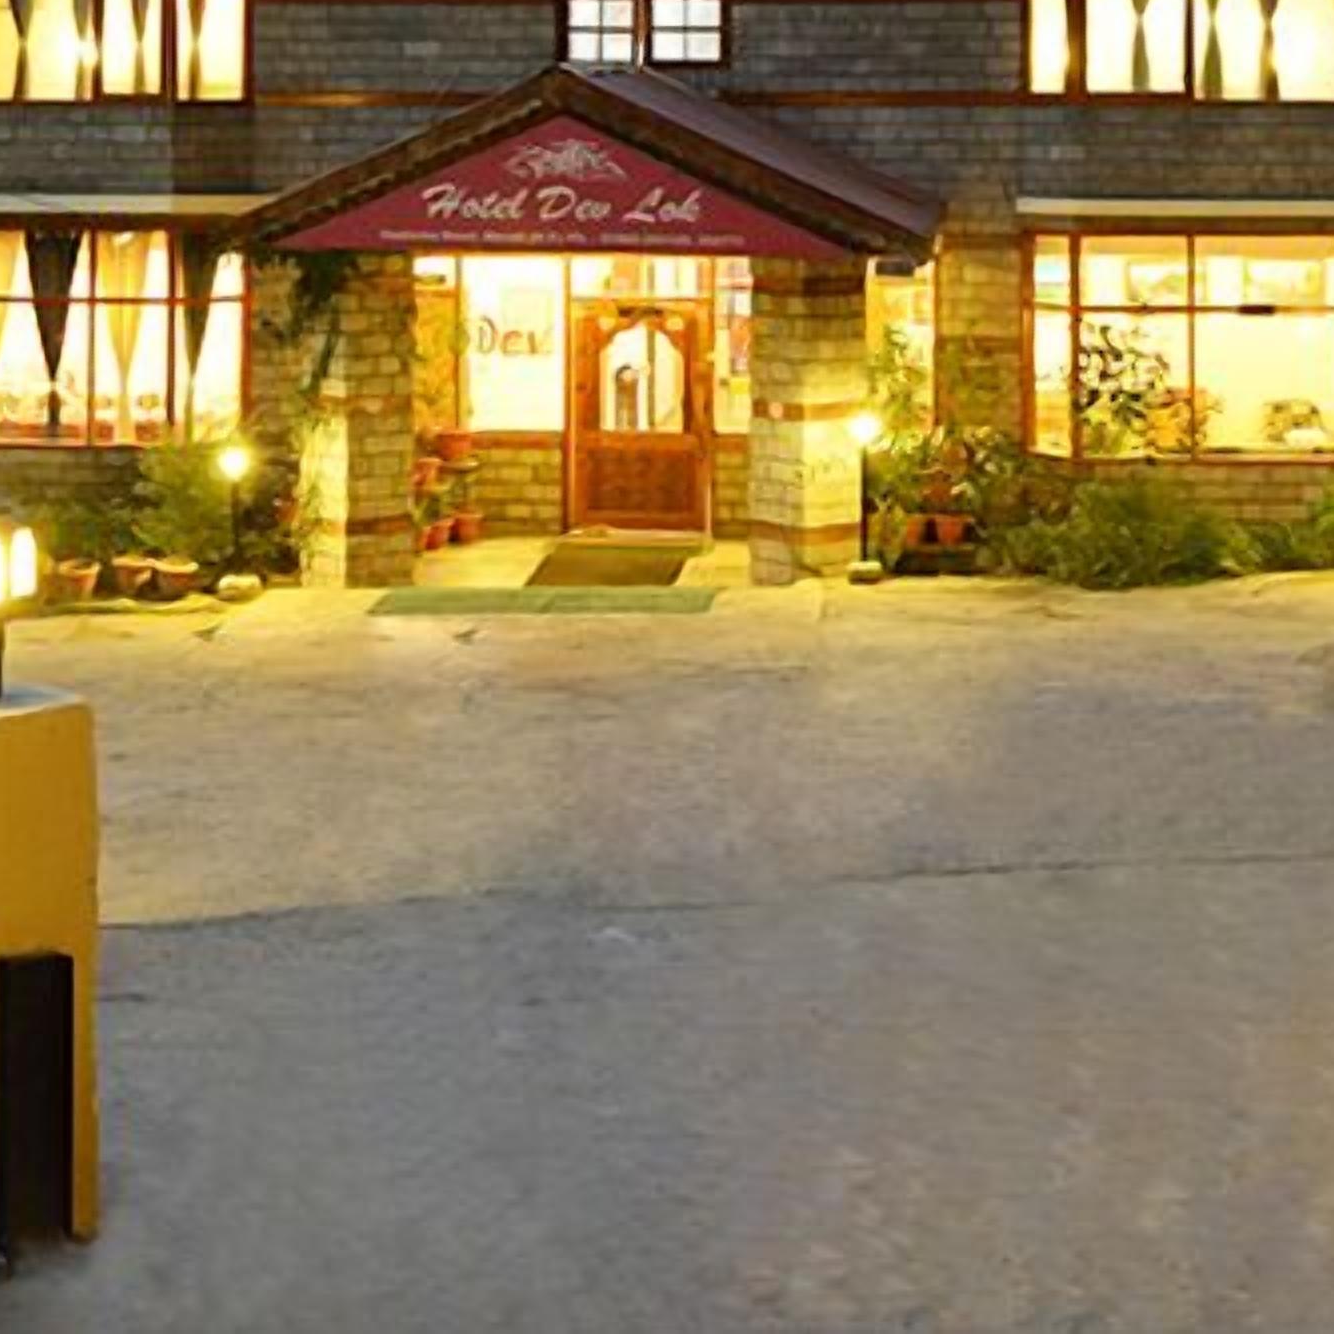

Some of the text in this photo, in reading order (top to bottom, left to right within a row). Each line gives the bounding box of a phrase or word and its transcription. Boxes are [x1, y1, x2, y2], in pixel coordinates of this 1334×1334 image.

[421, 183, 702, 223] Hotel Dev Lok
